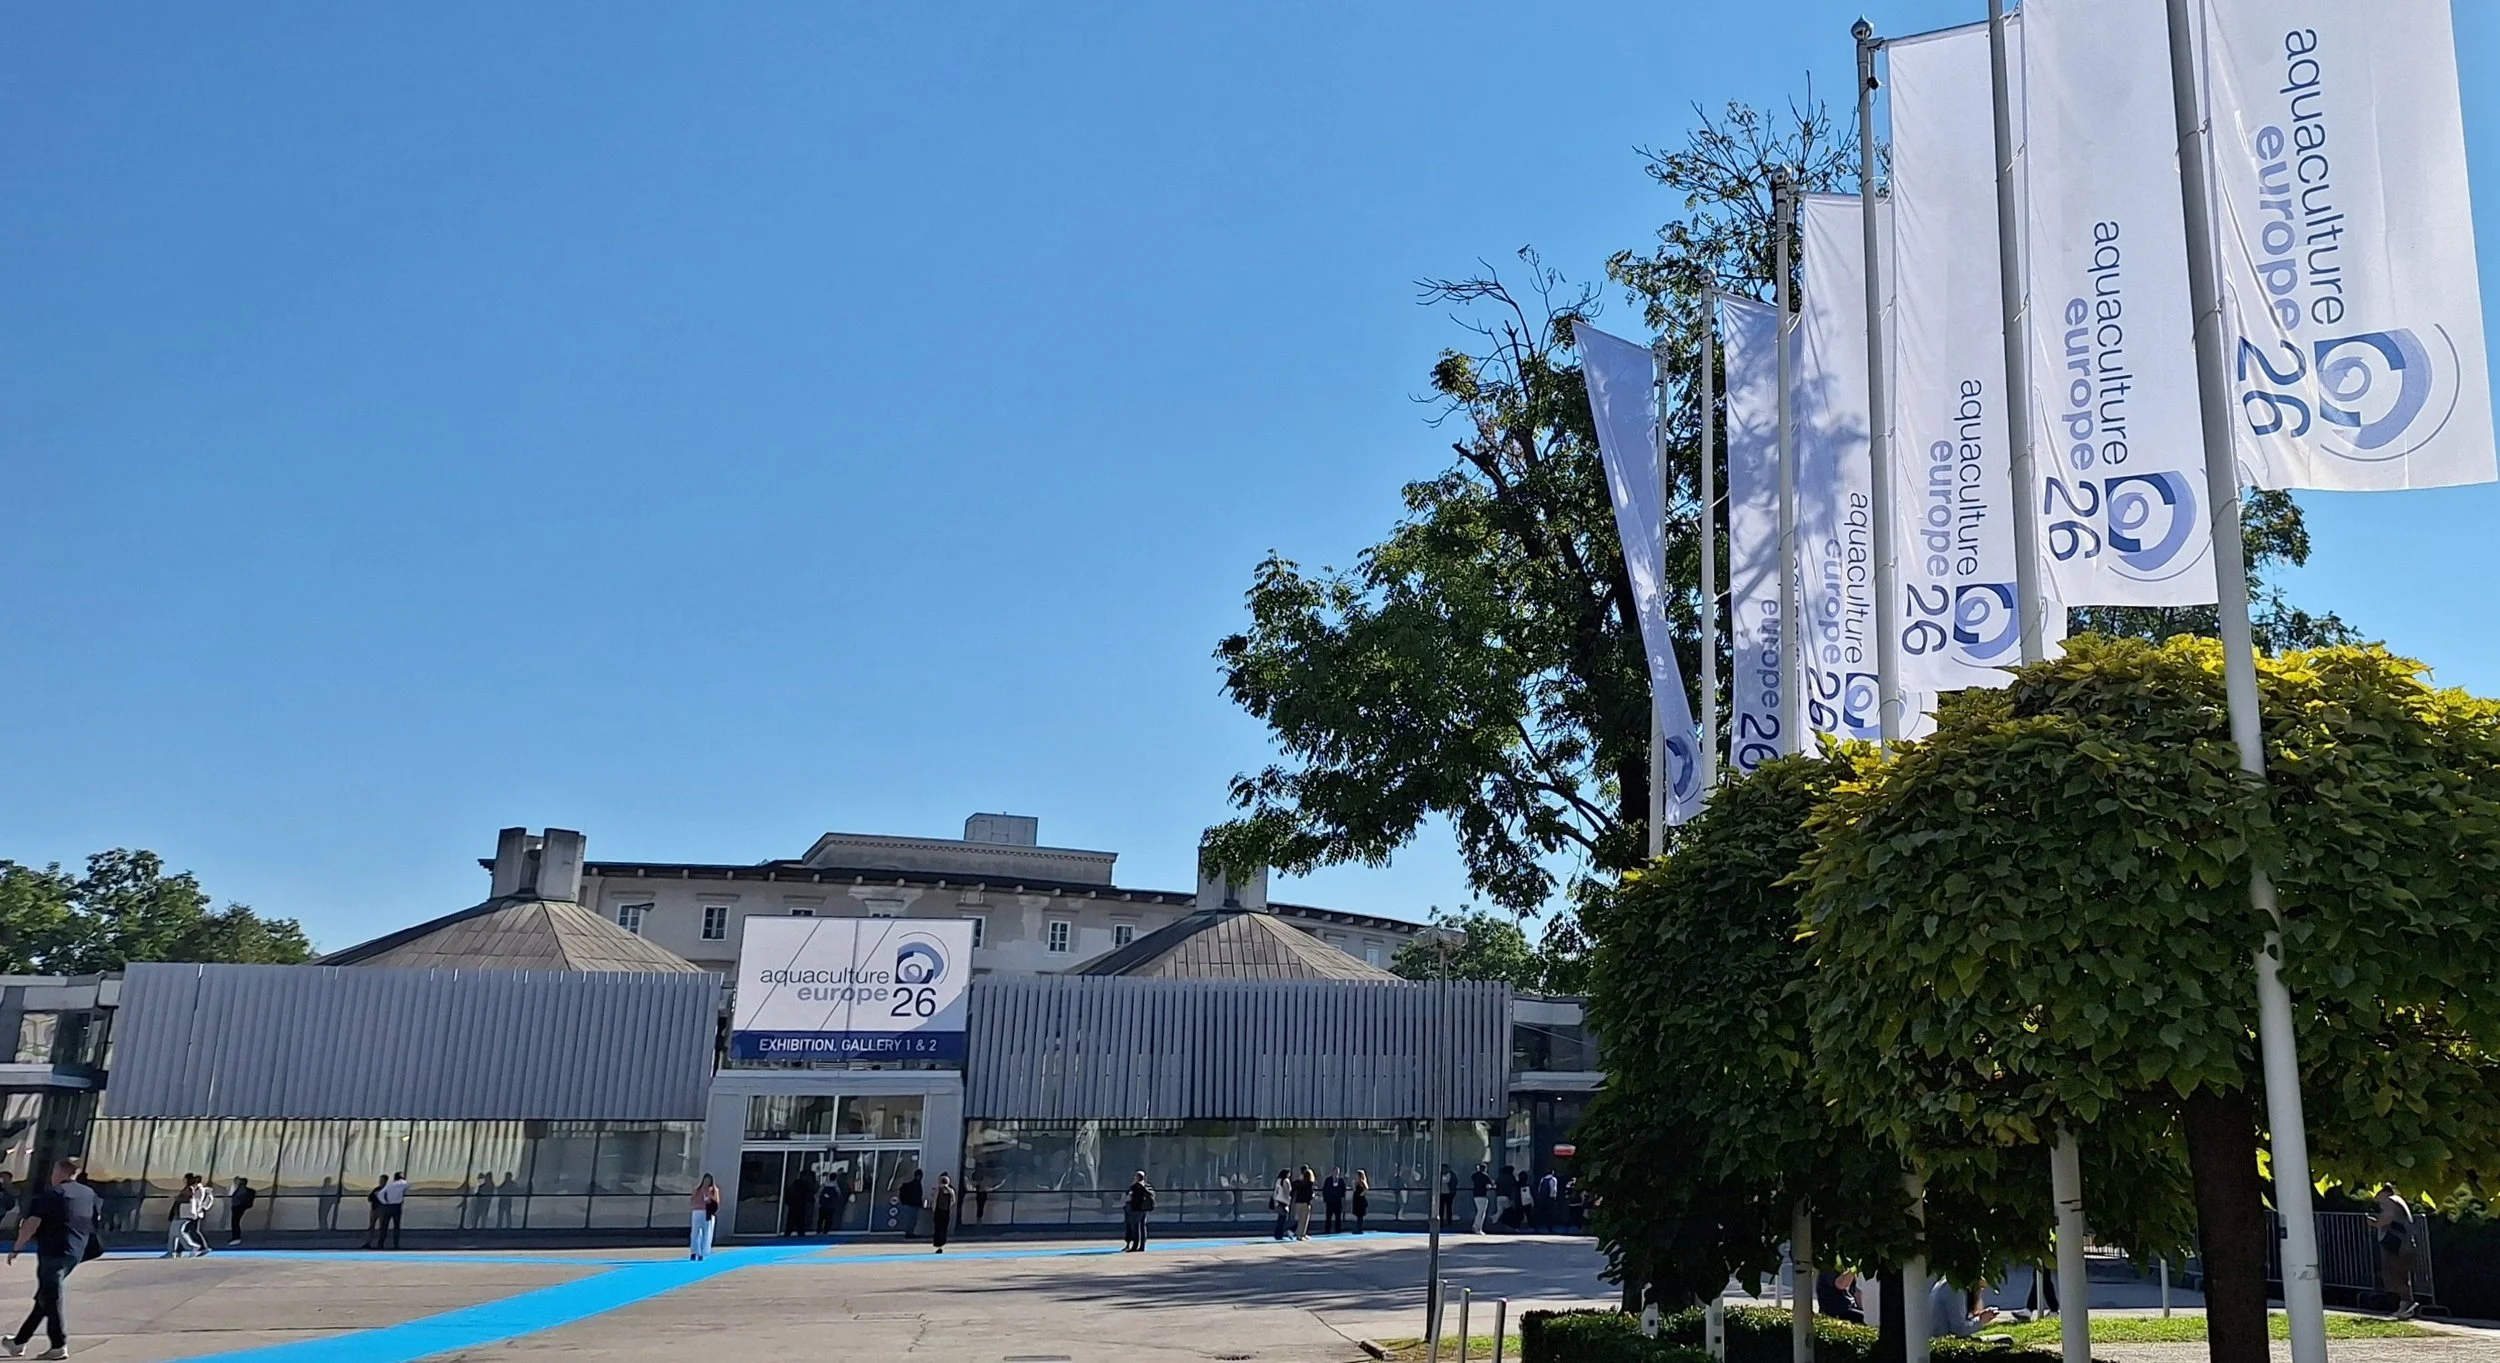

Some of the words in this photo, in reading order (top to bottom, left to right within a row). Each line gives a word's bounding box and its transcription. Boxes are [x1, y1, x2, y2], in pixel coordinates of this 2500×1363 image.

[2255, 125, 2301, 332] europe
[2279, 28, 2344, 326] aquaculture
[2061, 297, 2095, 471] europe
[2087, 221, 2133, 465] aquaculture
[2237, 335, 2311, 438] 26
[1920, 439, 1953, 577] europe
[1953, 379, 1988, 576] aquaculture
[2044, 476, 2101, 561] 26
[1818, 538, 1843, 665] europe
[1843, 492, 1871, 664] aquaculture
[1901, 583, 1950, 655] 26
[1756, 599, 1780, 709] europe
[1808, 667, 1841, 732] 26
[1738, 712, 1781, 771] 26
[759, 966, 890, 987] aquaculture
[797, 984, 889, 1005] europe
[890, 987, 937, 1018] 26
[759, 1038, 838, 1052] EXHIBITION,
[841, 1038, 902, 1051] GALLERY
[906, 1039, 911, 1051] 1
[915, 1039, 926, 1051] &
[928, 1039, 937, 1051] 2
